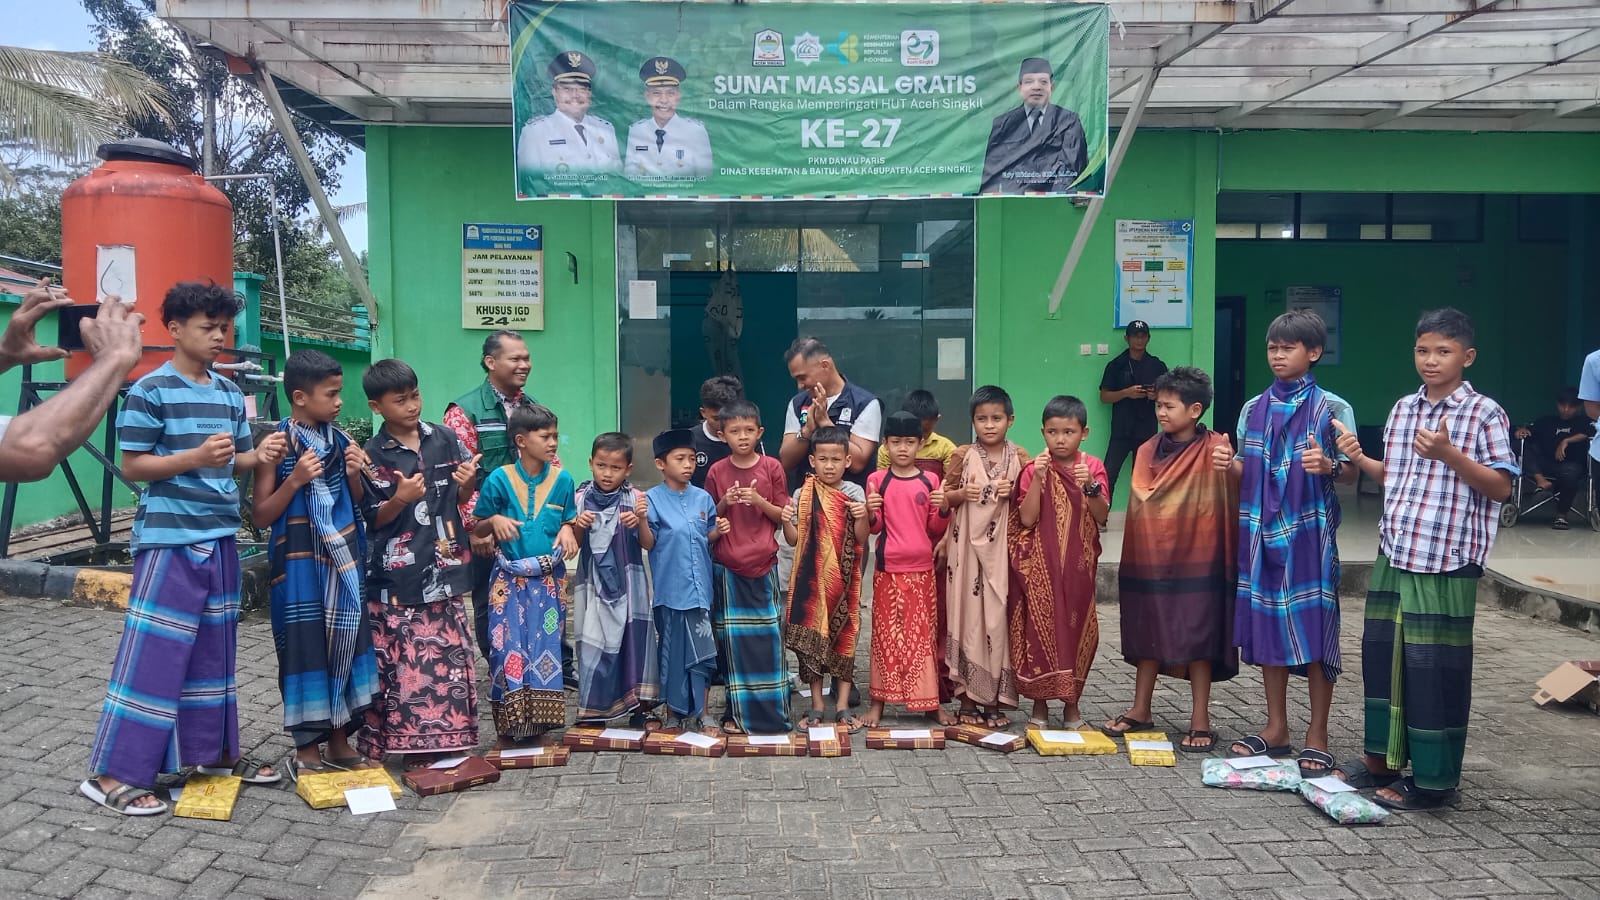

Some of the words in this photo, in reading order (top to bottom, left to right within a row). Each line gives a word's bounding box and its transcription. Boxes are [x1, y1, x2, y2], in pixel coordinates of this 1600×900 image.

[714, 75, 790, 94] SUNAT
[796, 75, 889, 94] MASSAL
[895, 75, 977, 94] GRATIS
[708, 98, 746, 110] Dalam
[750, 98, 794, 112] Rangka
[797, 98, 878, 112] Memperingati
[882, 98, 908, 109] HUT
[910, 98, 939, 109] Aceh
[942, 98, 984, 110] Singkil
[802, 118, 901, 148] KE-27
[860, 156, 886, 164] PARIS
[720, 168, 747, 176] DINAS
[749, 168, 800, 176] KESEHATAN
[810, 167, 840, 175] BAITUL
[842, 167, 860, 175] MAL
[862, 166, 912, 174] KABUPATEN
[476, 306, 512, 315] KHUSUS
[515, 306, 530, 315] IGD
[481, 316, 509, 326] 24
